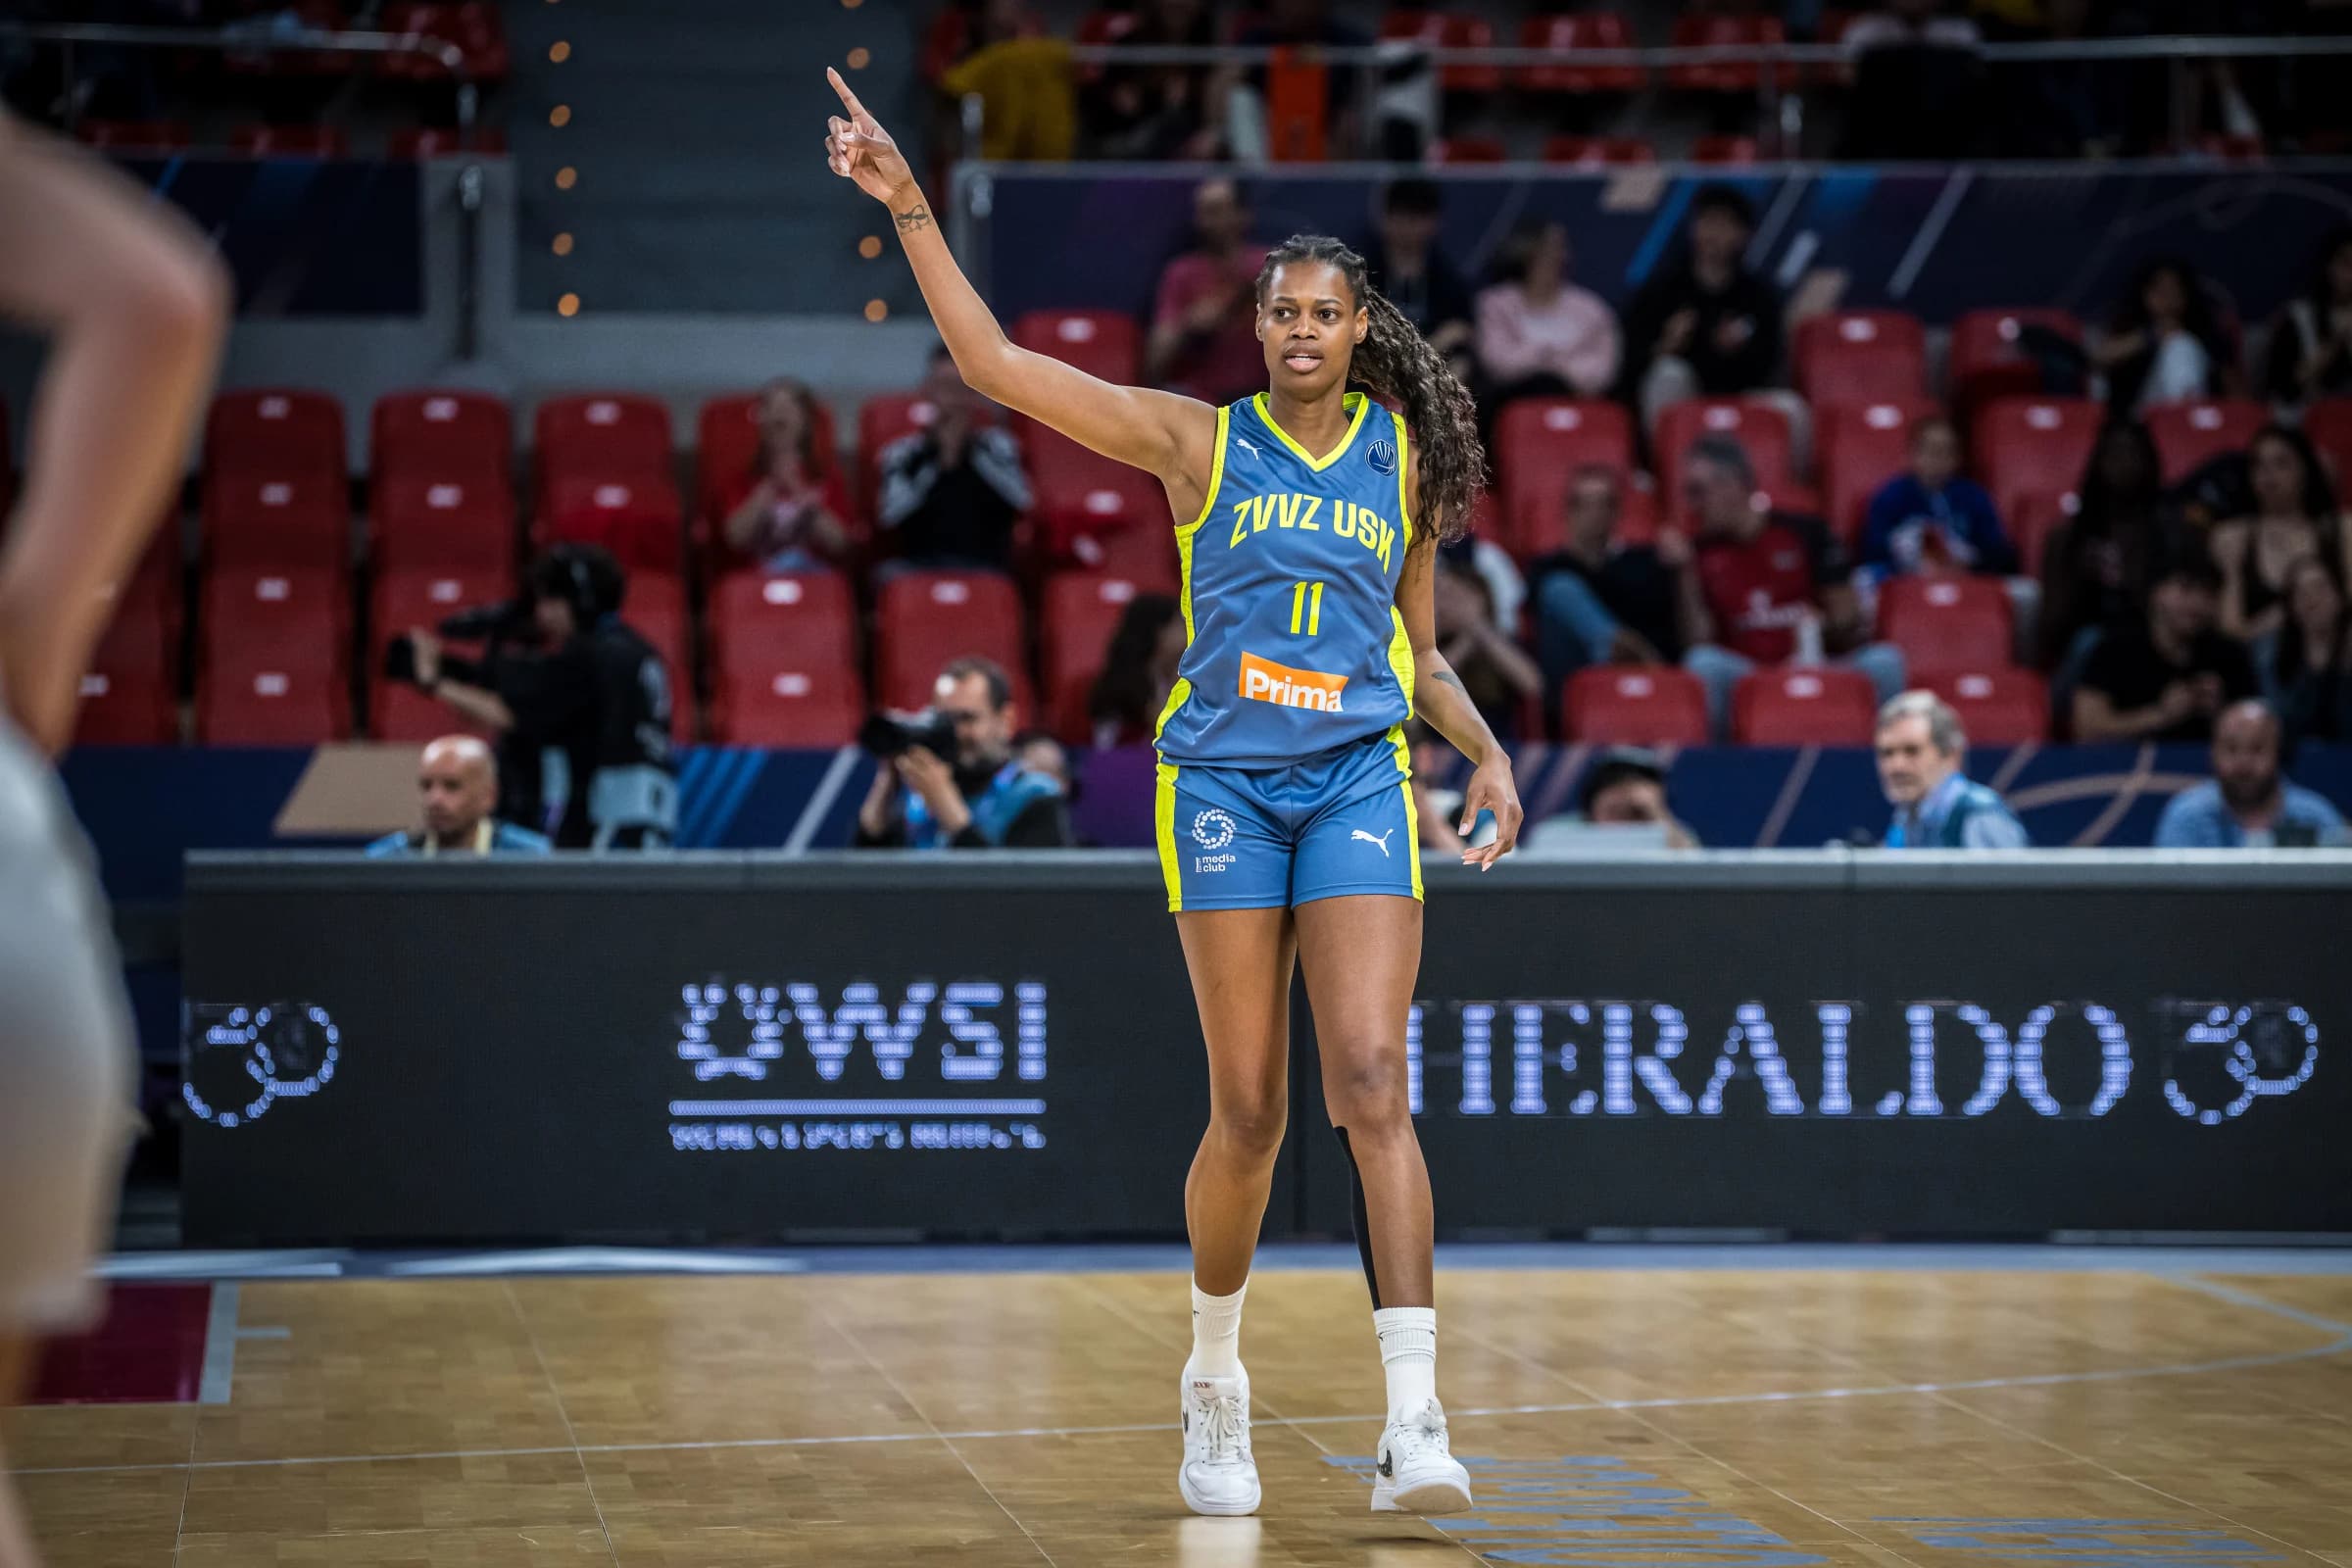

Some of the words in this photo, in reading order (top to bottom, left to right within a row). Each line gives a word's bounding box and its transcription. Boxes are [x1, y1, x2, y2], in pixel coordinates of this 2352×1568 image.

[1230, 493, 1322, 549] ZVVZ
[1333, 499, 1396, 575] USK
[1290, 582, 1324, 635] 11
[1245, 667, 1344, 712] Prima
[1202, 854, 1236, 863] media
[1202, 862, 1226, 872] club
[1407, 1004, 2132, 1116] HERALDO
